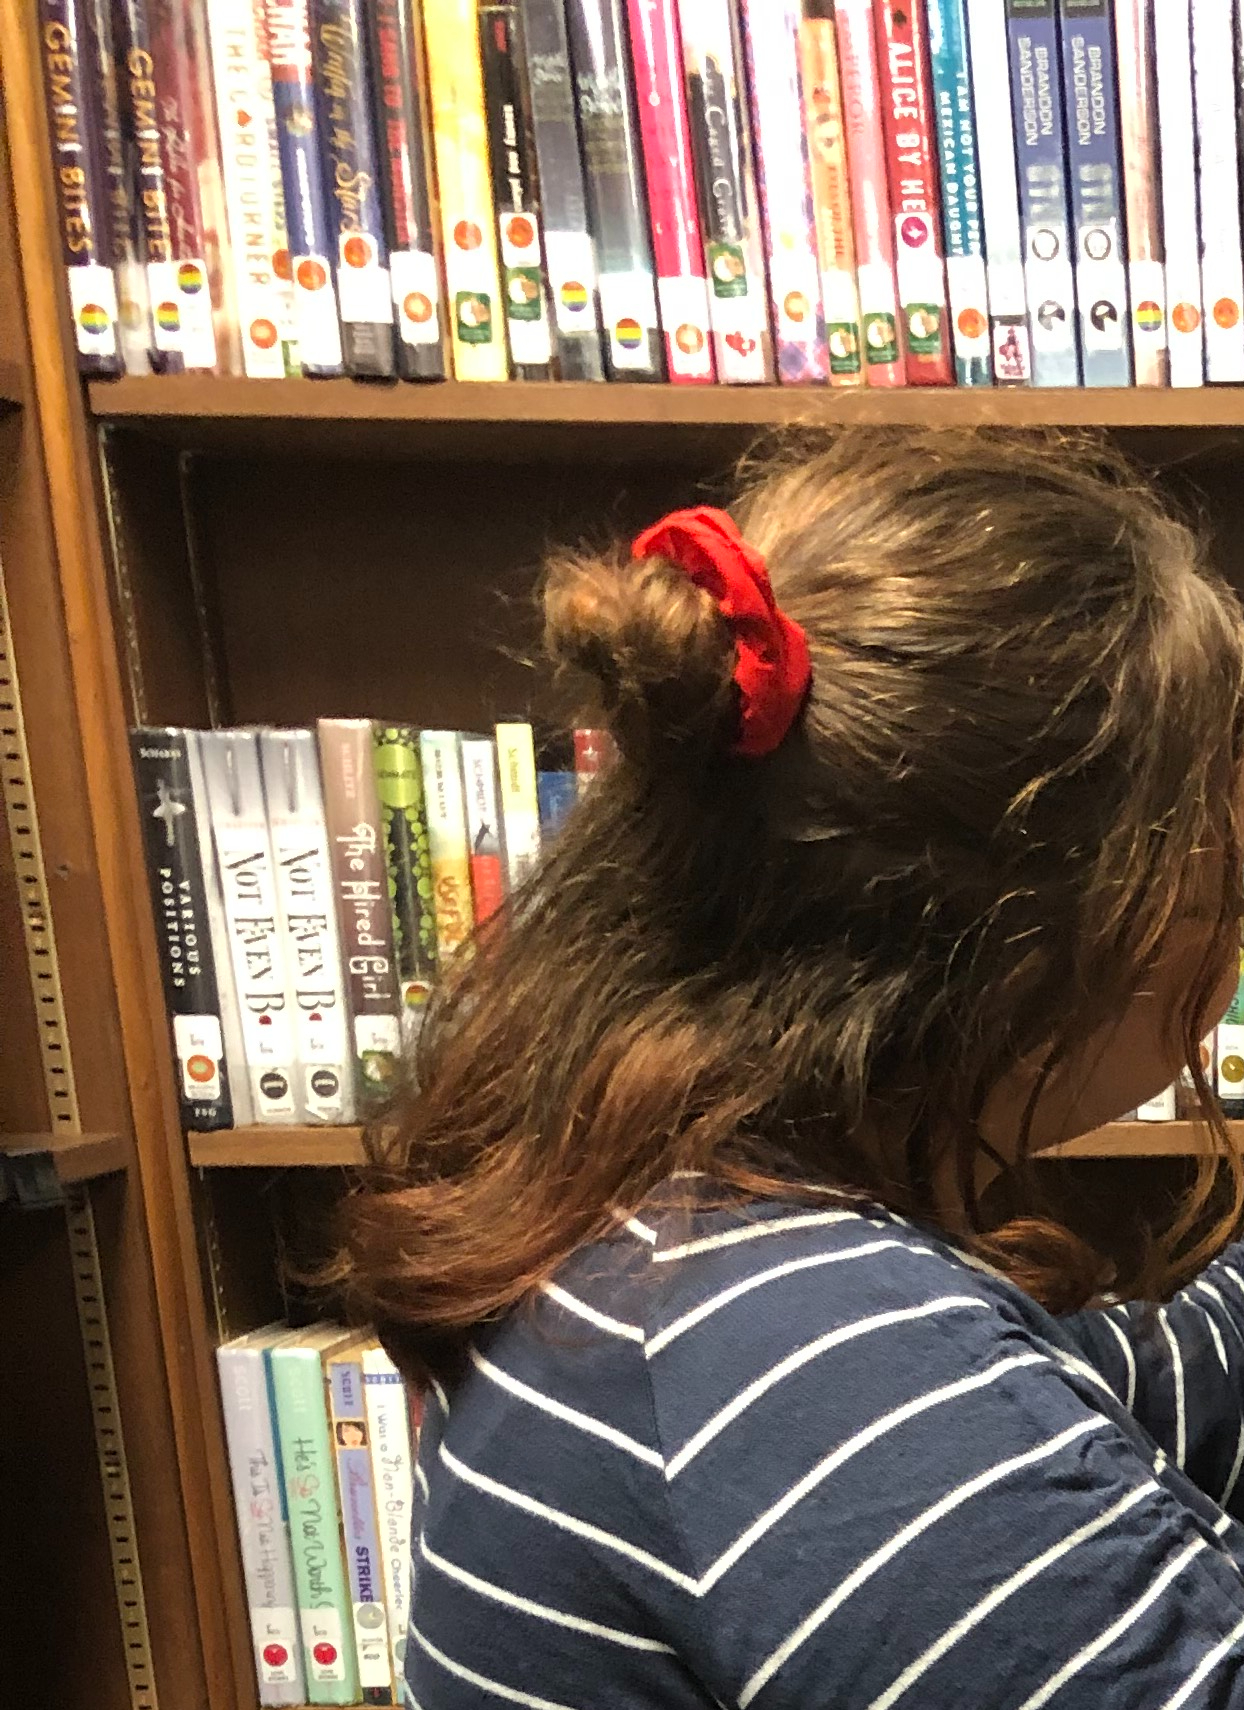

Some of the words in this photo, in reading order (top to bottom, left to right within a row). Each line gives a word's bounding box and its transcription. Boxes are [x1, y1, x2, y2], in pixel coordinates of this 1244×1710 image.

[44, 22, 84, 153] GEMINI
[127, 49, 169, 175] GEMINI
[887, 42, 919, 119] ALICE
[957, 85, 970, 112] AM
[1017, 36, 1038, 147] SANDERSON
[1035, 46, 1054, 135] BRANDON
[1070, 35, 1092, 146] SANDERSON
[1087, 46, 1107, 135] BRANDON
[896, 132, 921, 164] BY
[939, 91, 957, 175] MEXICAN
[958, 119, 974, 156] NOT
[60, 165, 92, 253] BITES
[232, 89, 270, 286] CRDTURNER
[899, 179, 928, 213] HE
[946, 182, 964, 256] DAUGHT
[962, 163, 978, 212] YOUR
[145, 188, 170, 262] BITE
[224, 849, 266, 905] NOT
[280, 847, 320, 902] NOT
[336, 821, 377, 873] The
[159, 867, 186, 989] POSITIONS
[178, 879, 201, 977] VARIOUS
[235, 916, 276, 980] EVEN
[288, 913, 328, 977] EVEN
[341, 880, 387, 955] Hired
[246, 991, 286, 1014] B
[296, 989, 336, 1011] B
[348, 956, 391, 1000] Girl
[290, 1438, 319, 1472] He's
[355, 1545, 379, 1603] STRIKE
